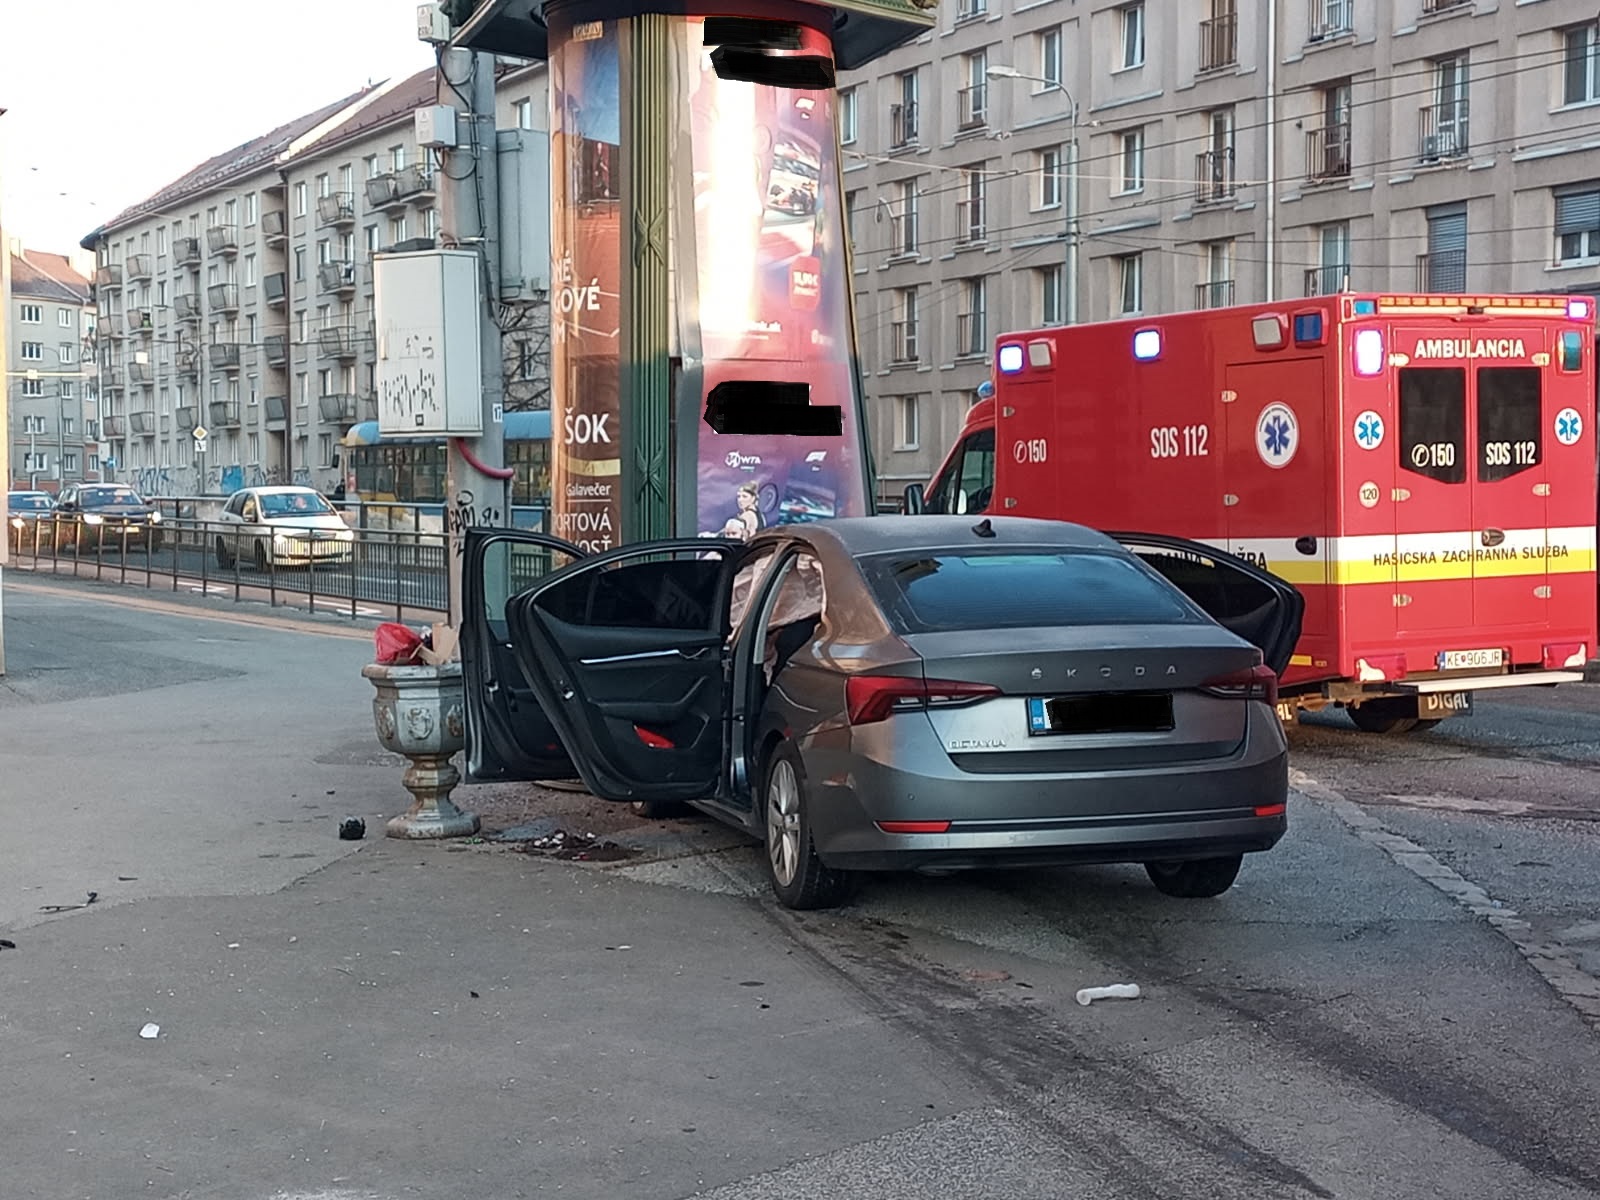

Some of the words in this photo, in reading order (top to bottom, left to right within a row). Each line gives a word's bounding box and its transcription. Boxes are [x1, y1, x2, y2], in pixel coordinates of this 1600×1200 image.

[1414, 339, 1526, 359] AMBULANCIA
[564, 407, 612, 445] ŠOK
[1027, 438, 1047, 463] 150
[1150, 426, 1179, 459] SOS
[1182, 424, 1209, 457] 112
[1429, 443, 1455, 467] 150
[1485, 442, 1511, 466] SOS
[1514, 441, 1536, 465] 112
[566, 482, 612, 497] Galavečer
[1361, 487, 1378, 500] 120
[555, 507, 612, 531] ORTOVÁ
[574, 534, 612, 554] OSŤ
[1446, 653, 1461, 667] KE
[1427, 692, 1469, 710] DIGAL
